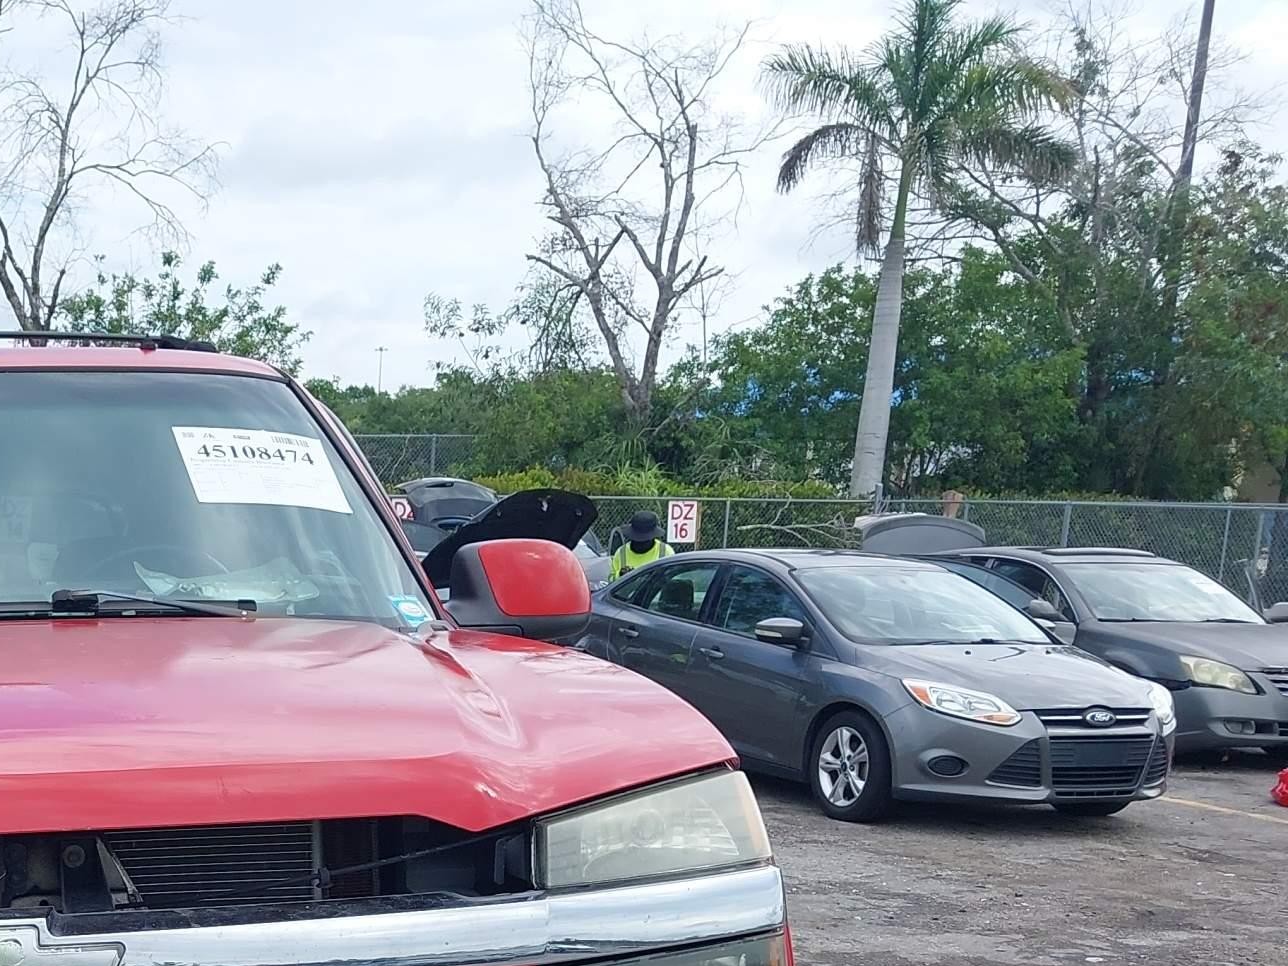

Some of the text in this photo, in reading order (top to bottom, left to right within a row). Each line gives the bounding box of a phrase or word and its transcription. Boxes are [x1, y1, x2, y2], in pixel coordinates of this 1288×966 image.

[197, 444, 314, 465] 45108474
[395, 501, 414, 518] D
[671, 503, 695, 520] DZ
[674, 522, 688, 539] 16
